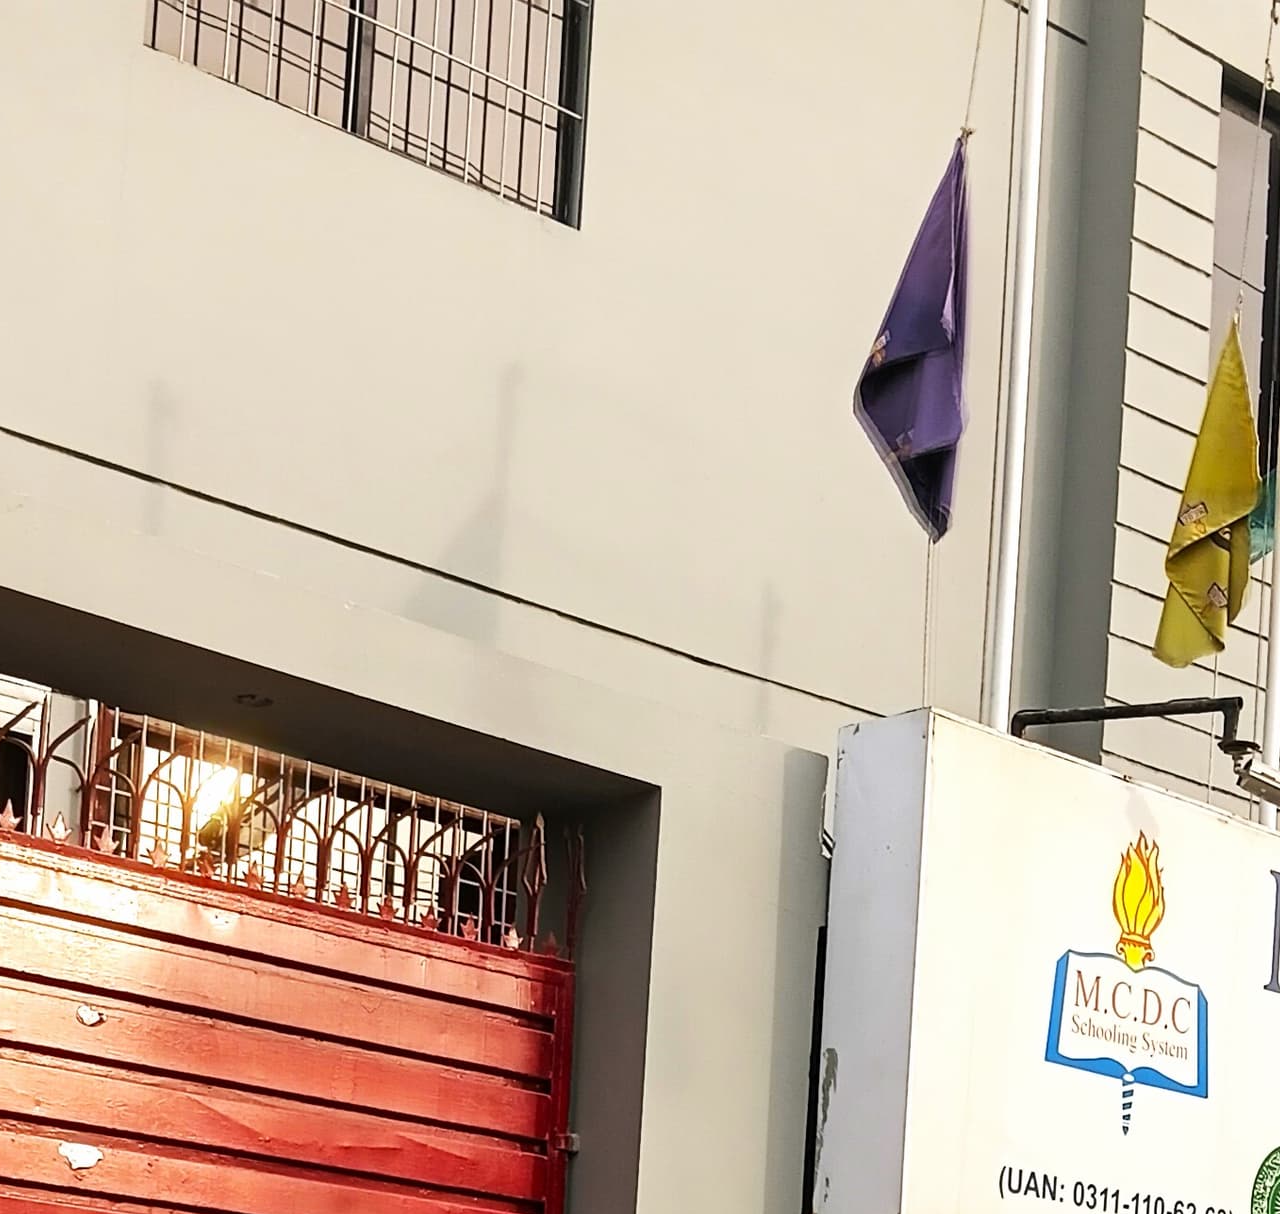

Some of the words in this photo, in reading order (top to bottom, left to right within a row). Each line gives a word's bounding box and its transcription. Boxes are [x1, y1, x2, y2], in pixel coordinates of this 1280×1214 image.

[1074, 969, 1192, 1034] M.C.D.C
[1071, 1014, 1137, 1053] Schooling
[1141, 1031, 1189, 1060] System
[998, 1165, 1065, 1203] (UAN:
